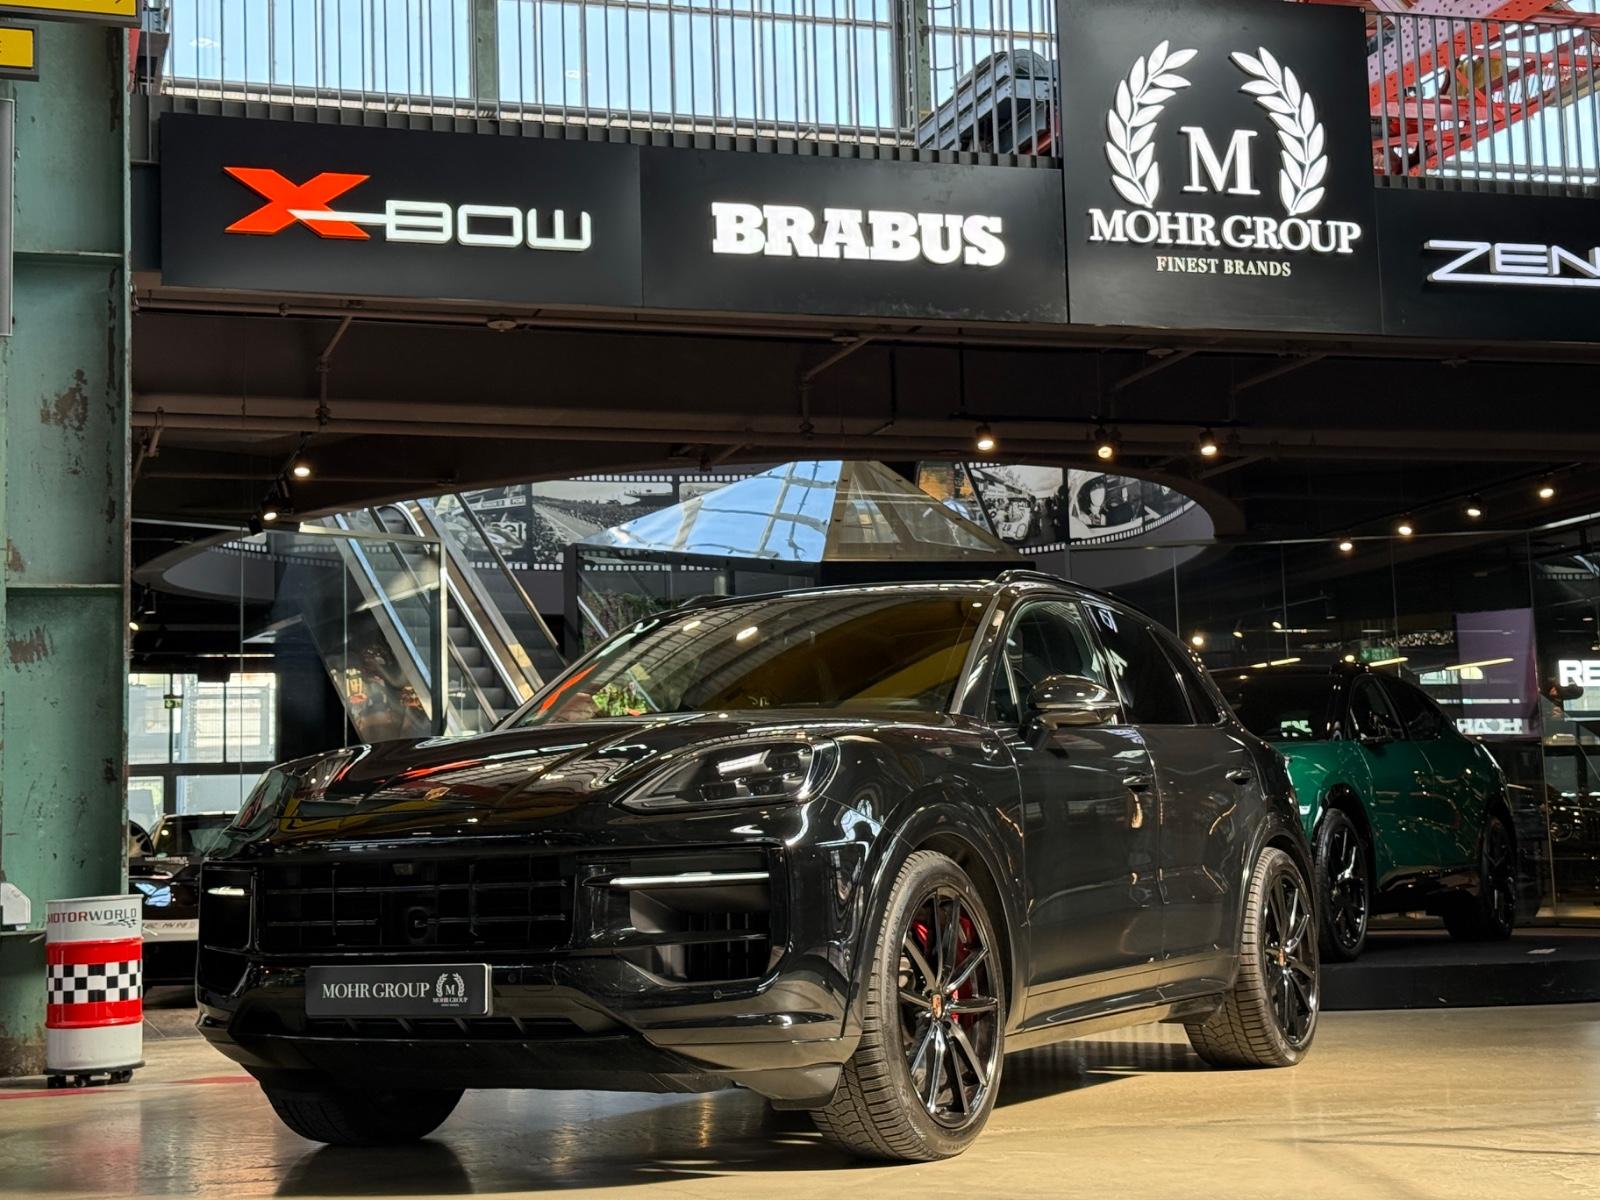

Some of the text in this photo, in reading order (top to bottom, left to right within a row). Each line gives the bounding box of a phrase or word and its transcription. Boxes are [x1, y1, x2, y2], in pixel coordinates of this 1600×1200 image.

[1180, 126, 1260, 196] M
[711, 202, 1006, 267] BRABUS
[1088, 208, 1362, 254] MOHR GROUP
[1156, 256, 1292, 277] FINEST BRANDS
[322, 982, 430, 999] MOHR GROUP
